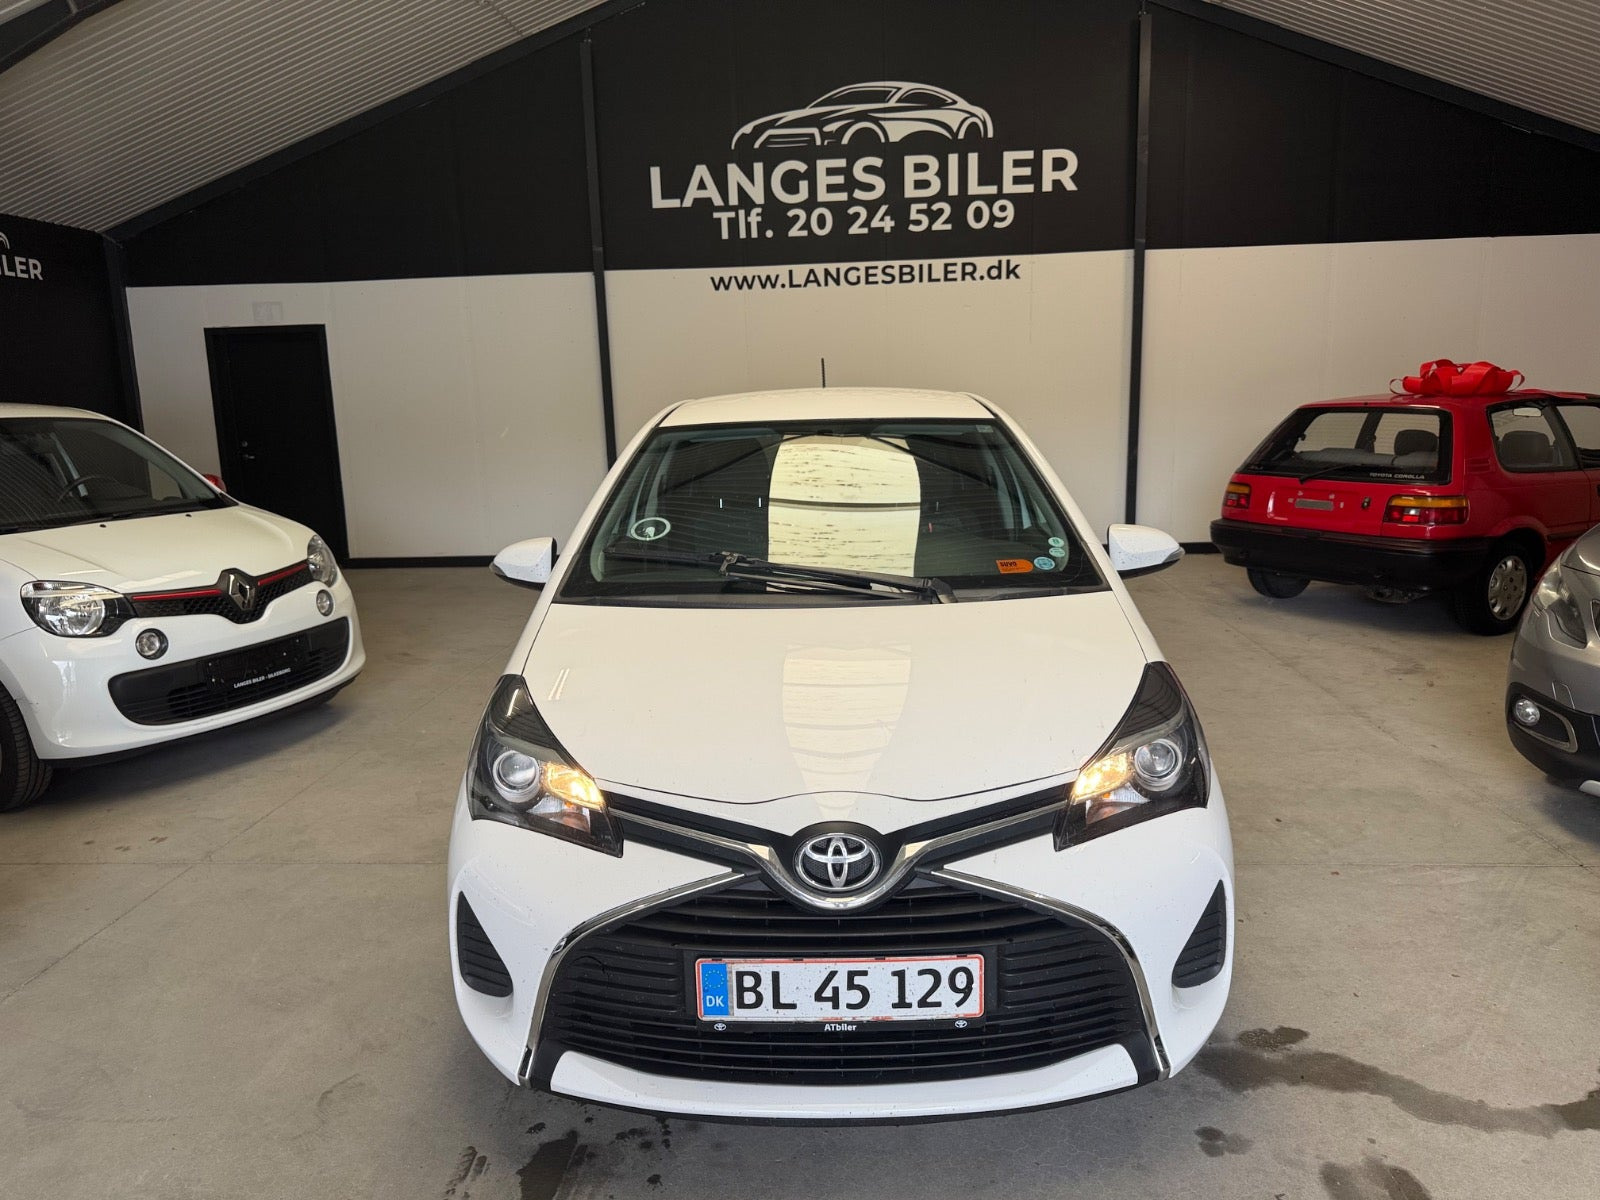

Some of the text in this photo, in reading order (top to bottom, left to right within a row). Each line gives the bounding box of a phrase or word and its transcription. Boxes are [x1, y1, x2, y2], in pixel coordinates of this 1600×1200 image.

[649, 148, 1079, 209] LANGES BILER
[712, 199, 1015, 240] Tlf. 20 24 52 09
[0, 254, 43, 281] LER
[710, 259, 1021, 291] www.LANGESBILER.dk
[233, 679, 252, 689] LANGES
[252, 675, 265, 684] BILER
[706, 995, 725, 1008] DK
[735, 966, 974, 1010] BL 45 129
